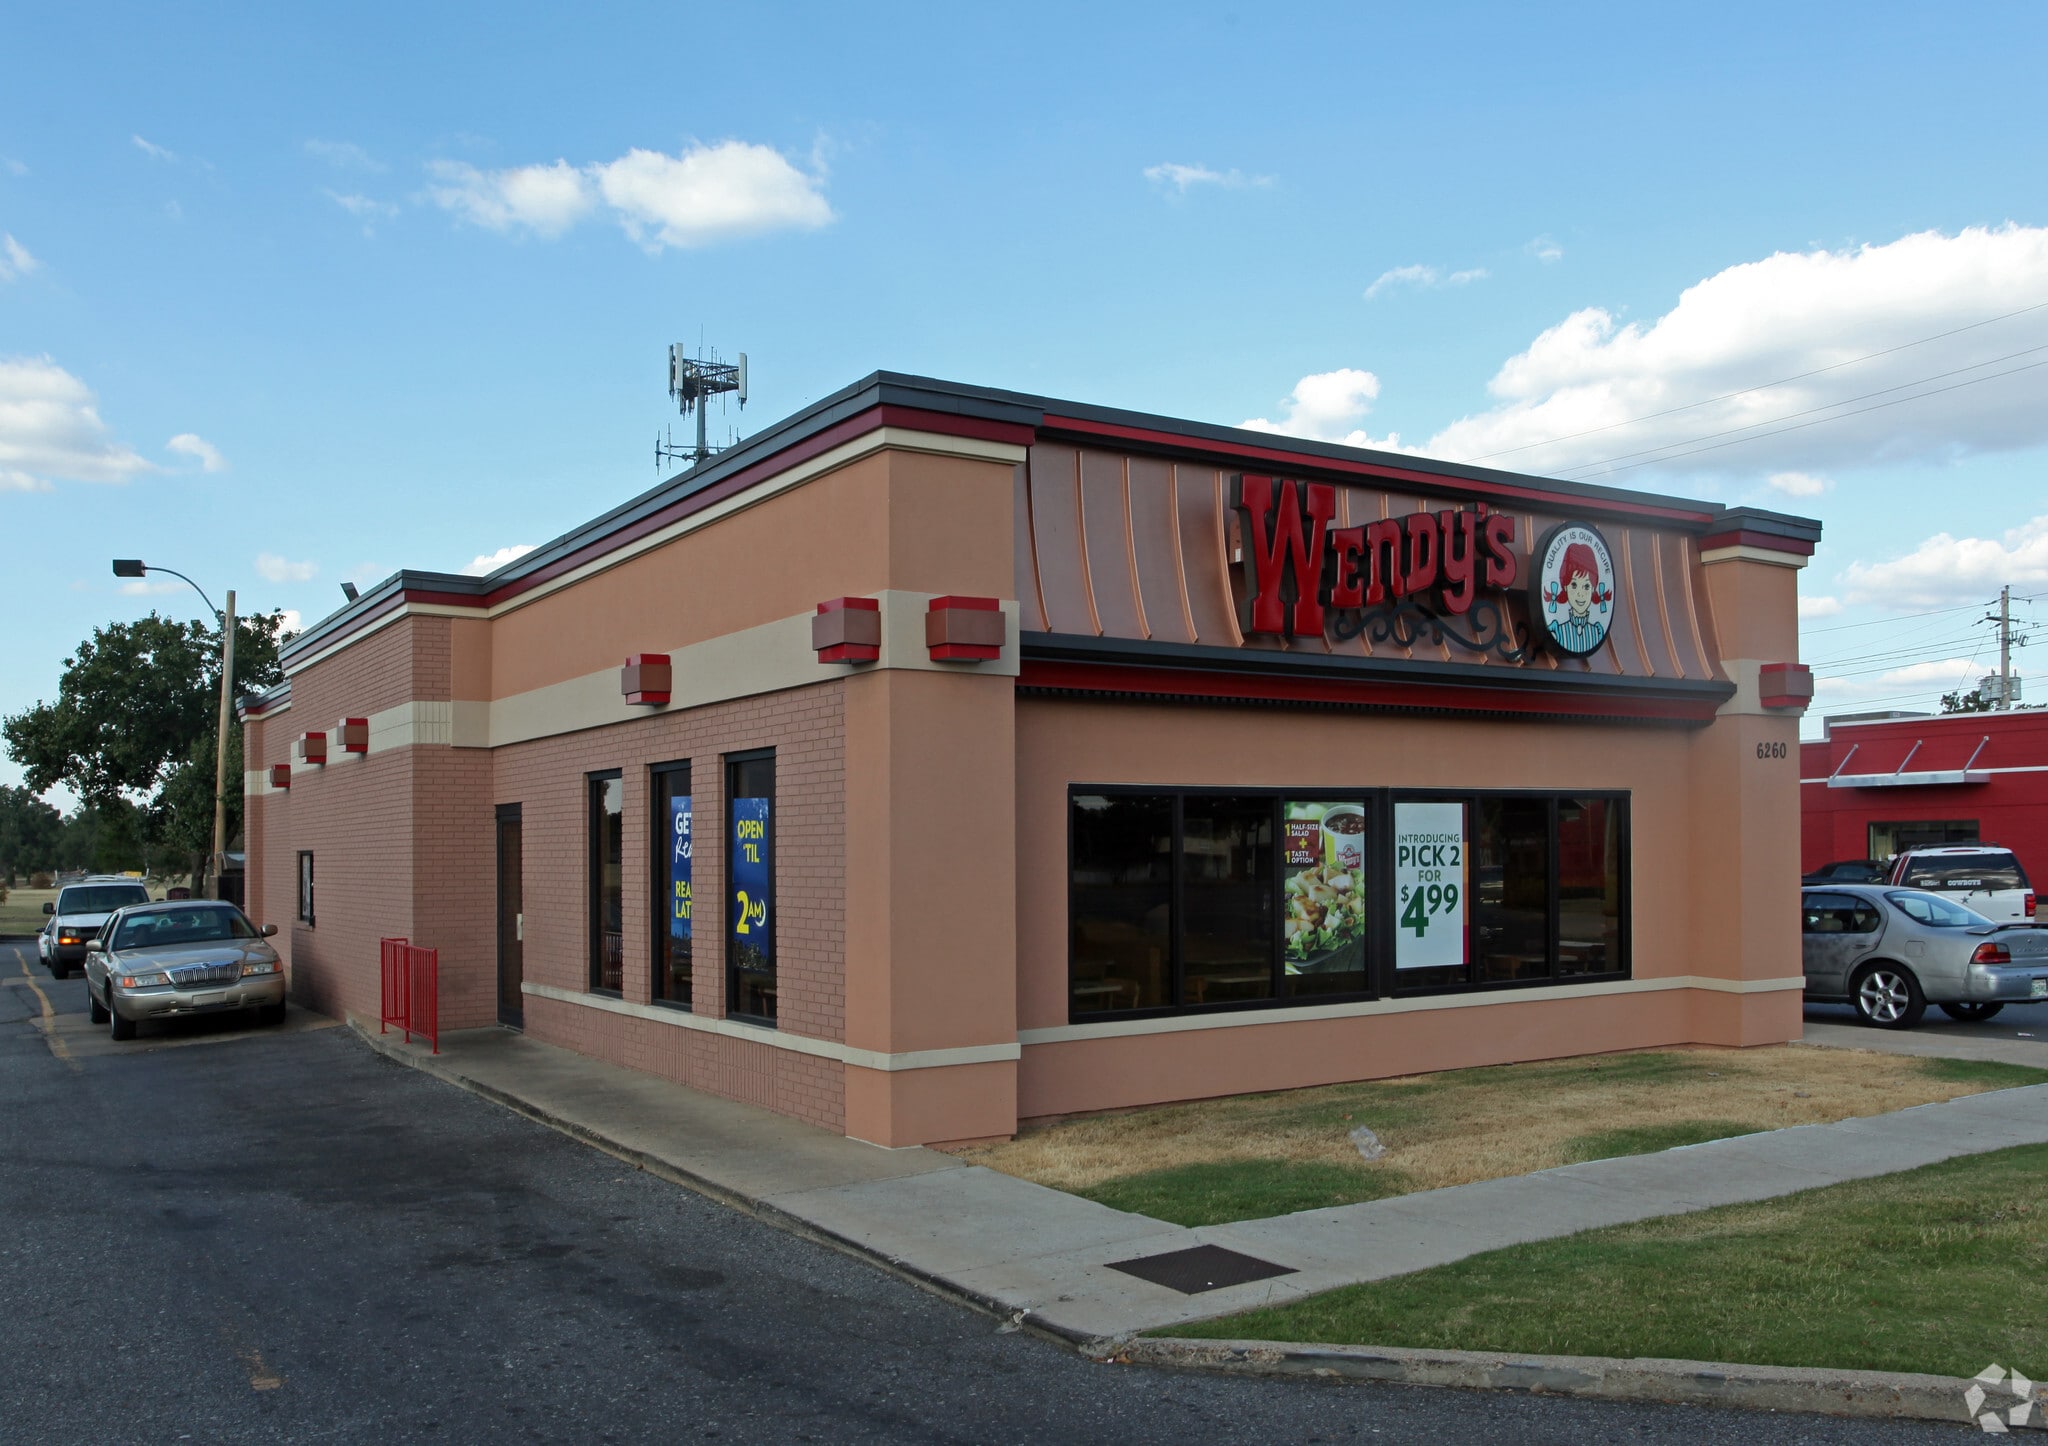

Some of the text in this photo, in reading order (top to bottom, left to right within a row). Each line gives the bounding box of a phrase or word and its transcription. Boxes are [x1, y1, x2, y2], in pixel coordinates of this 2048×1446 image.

[1546, 531, 1611, 575] QUALITY IS OUR RECIPE
[1757, 742, 1787, 759] 6260
[737, 820, 764, 839] OPEN
[1284, 823, 1319, 837] 1 HALF-SIZE
[1398, 833, 1460, 844] INTRODUCING
[1284, 850, 1291, 864] 1
[1398, 845, 1460, 867] PICK 2
[1418, 869, 1441, 882] FOR
